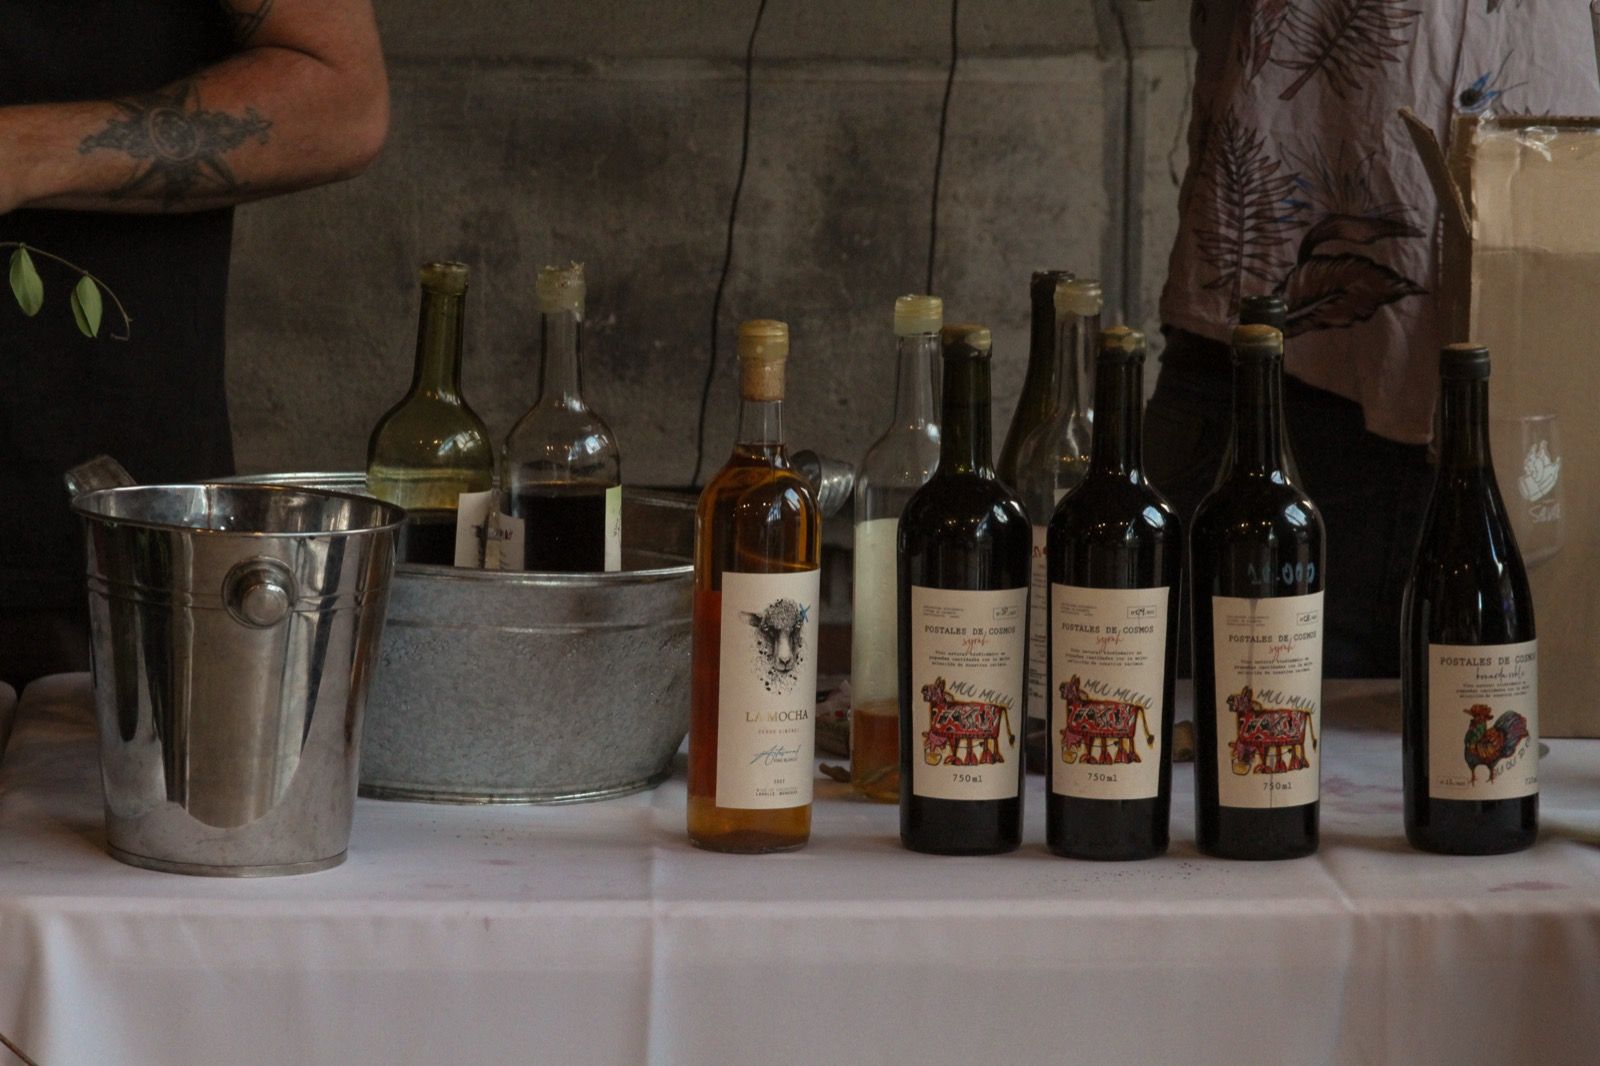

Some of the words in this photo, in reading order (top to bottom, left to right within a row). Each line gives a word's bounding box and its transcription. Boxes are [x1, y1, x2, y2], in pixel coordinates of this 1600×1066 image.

[924, 625, 967, 635] POSTALES
[972, 627, 984, 635] DE
[988, 626, 1016, 635] COSMOS
[1061, 623, 1101, 634] POSTALES
[1105, 626, 1118, 634] DE
[1122, 625, 1154, 634] COSMOS
[1228, 634, 1273, 644] POSTALES
[1278, 634, 1289, 642] DE
[1293, 631, 1317, 641] COSMOS
[1440, 656, 1492, 666] POSTALES
[1498, 656, 1510, 665] DE
[745, 711, 761, 722] LA
[767, 709, 808, 722] MOCHA
[952, 773, 983, 783] 750ml
[1087, 772, 1118, 782] 750ml
[1263, 782, 1292, 791] 750ml
